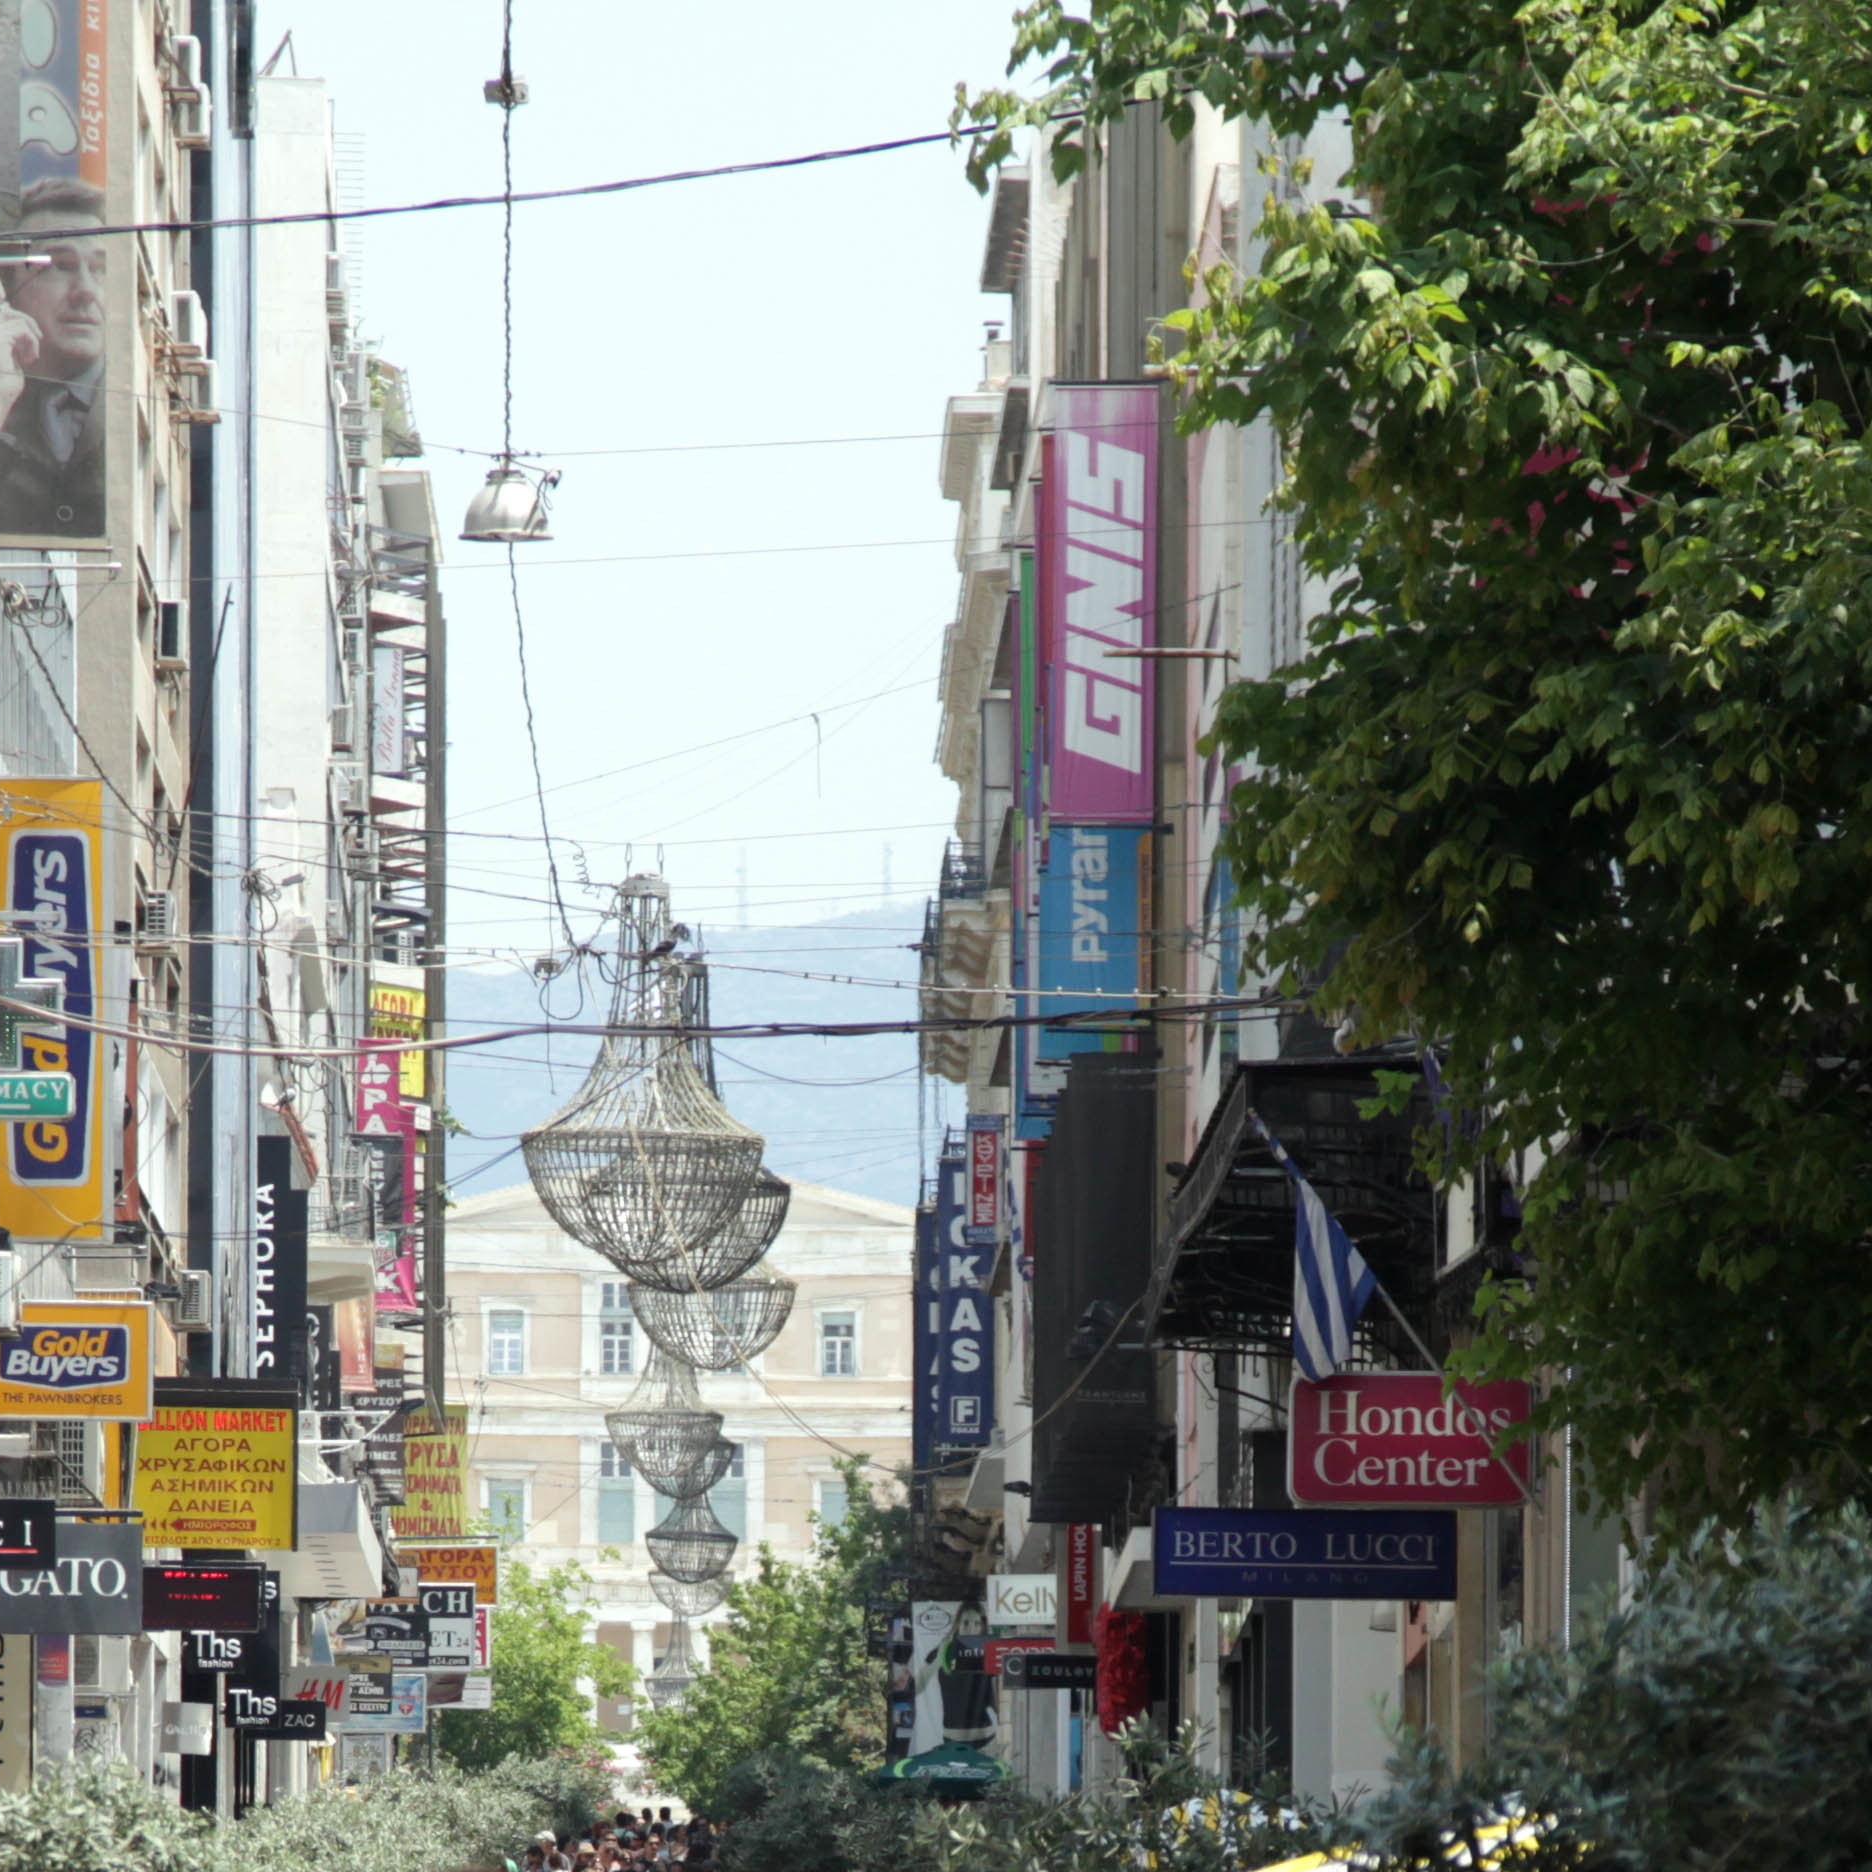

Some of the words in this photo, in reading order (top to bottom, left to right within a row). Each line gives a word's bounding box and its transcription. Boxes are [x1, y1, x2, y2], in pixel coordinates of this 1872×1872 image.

[81, 52, 102, 154] Ταξίδια
[1064, 430, 1145, 774] GINIS
[23, 1033, 69, 1163] Gd
[256, 1183, 274, 1369] SEPHORA
[32, 1330, 109, 1357] Gold
[5, 1349, 119, 1382] Buyers
[2, 1392, 24, 1403] THE
[28, 1392, 123, 1406] PAWNBROKERS
[139, 1410, 208, 1431] LLION
[214, 1411, 287, 1432] MARKET
[1314, 1390, 1512, 1438] Hondos
[174, 1438, 251, 1452] ΑΓΟΡΑ
[405, 1442, 459, 1468] ΡΥΣΑ
[138, 1457, 286, 1472] ΧΡΥΣΑΦΙΚΩΝ
[1313, 1438, 1489, 1487] Center
[150, 1479, 274, 1493] ΑΣΗΜΙΚΩΝ
[168, 1499, 255, 1513] ΔΑΝΕΙΑ
[1173, 1531, 1297, 1560] BERTO
[1324, 1533, 1439, 1562] LUCCI
[419, 1565, 493, 1579] ΡΥΣΟΥ
[1073, 1558, 1088, 1601] LAPIN
[1241, 1570, 1369, 1585] MILANO
[191, 1630, 242, 1658] Ths
[198, 1659, 234, 1669] fashion
[229, 1688, 277, 1715] Ths
[296, 1680, 345, 1711] HM
[236, 1715, 270, 1725] fashion
[284, 1714, 316, 1728] ZAC
